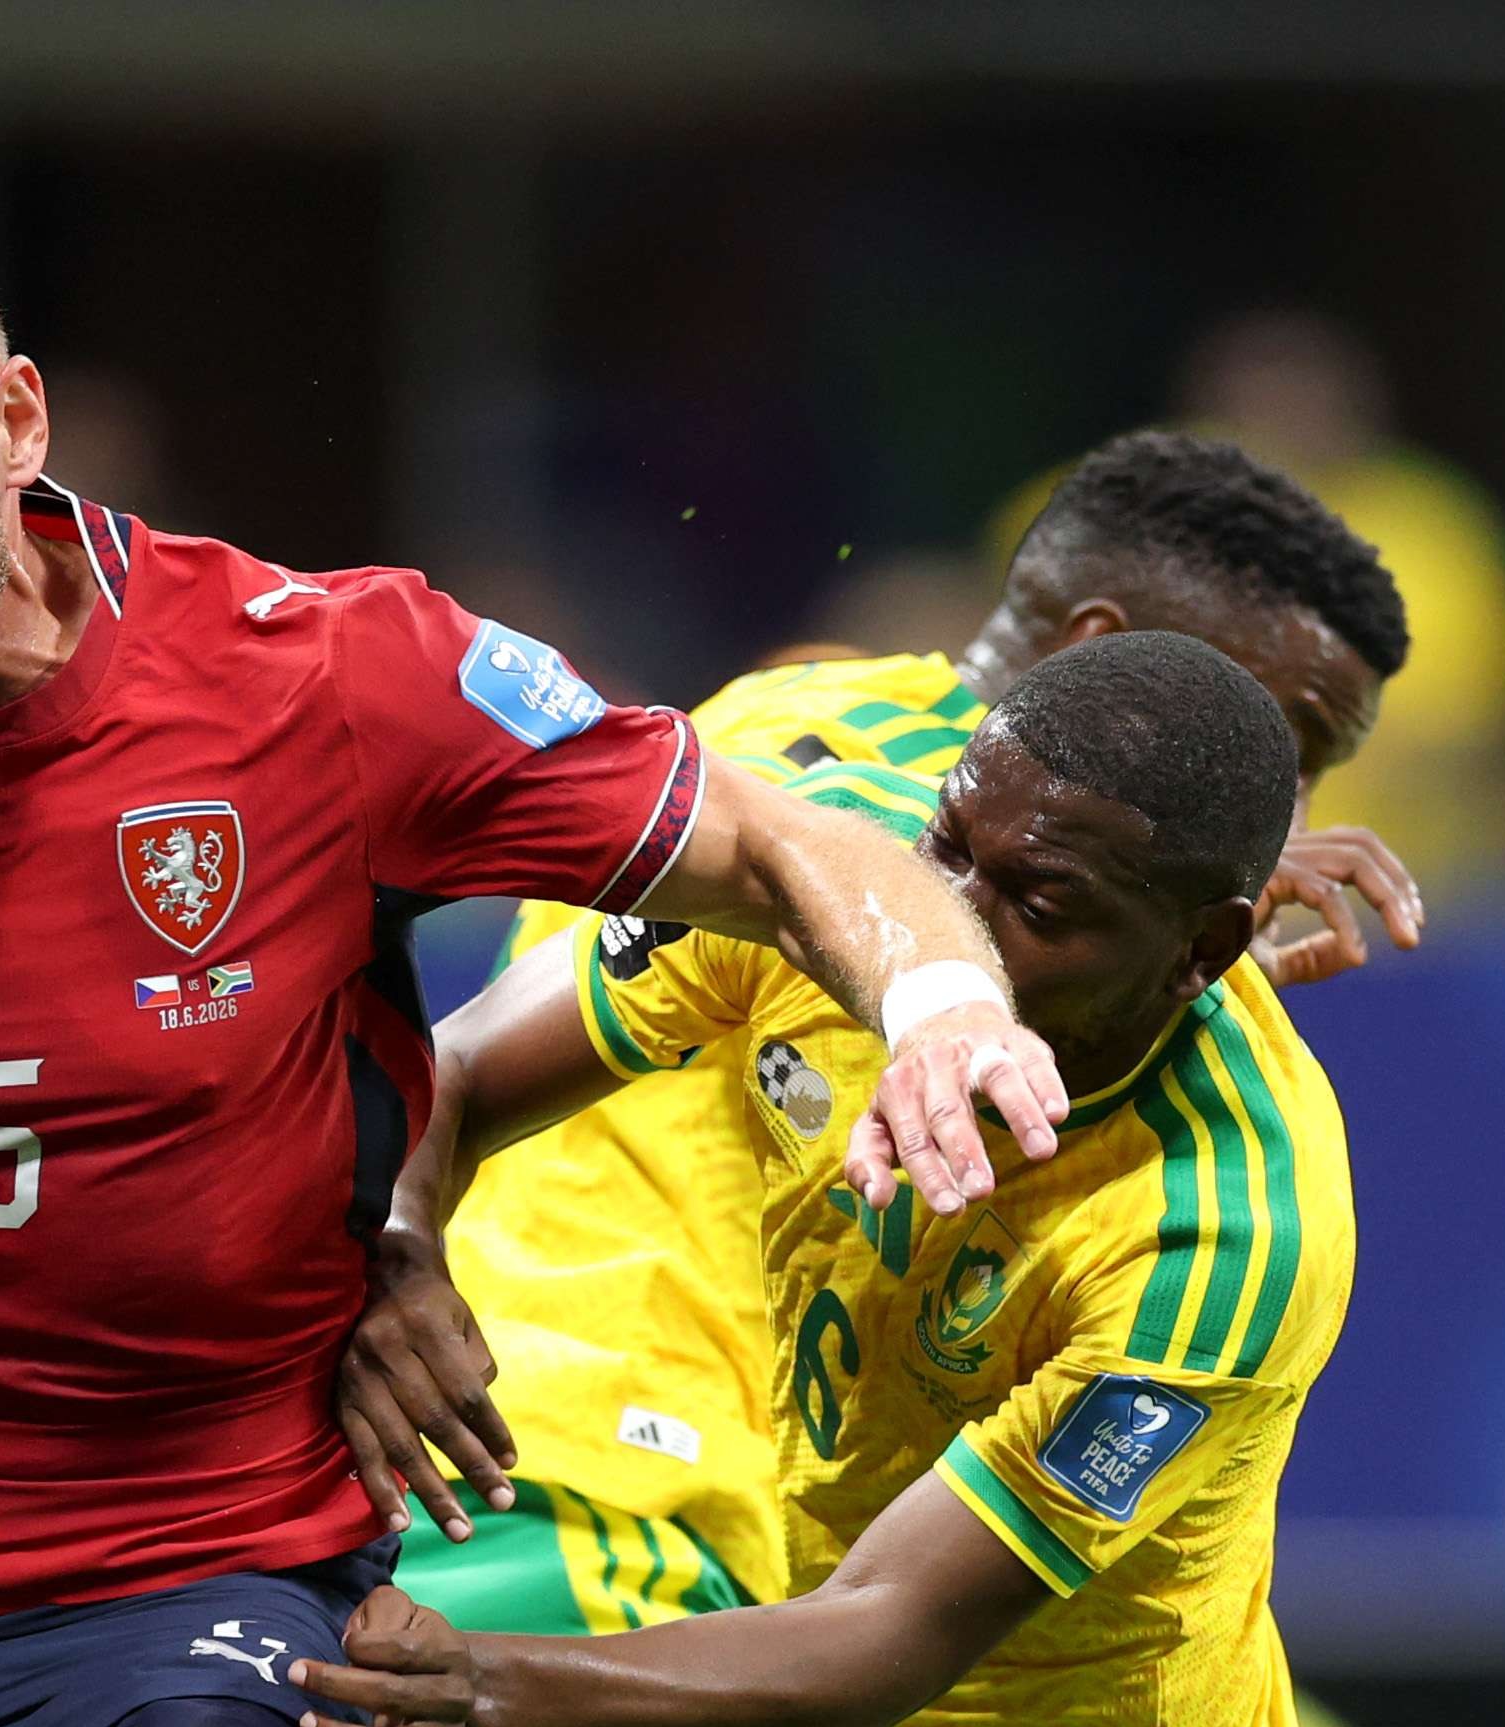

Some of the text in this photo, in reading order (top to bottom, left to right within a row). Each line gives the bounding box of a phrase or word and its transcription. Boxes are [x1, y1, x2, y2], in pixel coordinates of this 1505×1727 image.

[158, 998, 238, 1030] 18.6.2026
[794, 1288, 861, 1461] 6
[1093, 1418, 1134, 1454] Unite
[1080, 1440, 1137, 1487] PEACE
[1079, 1468, 1110, 1497] FIFA
